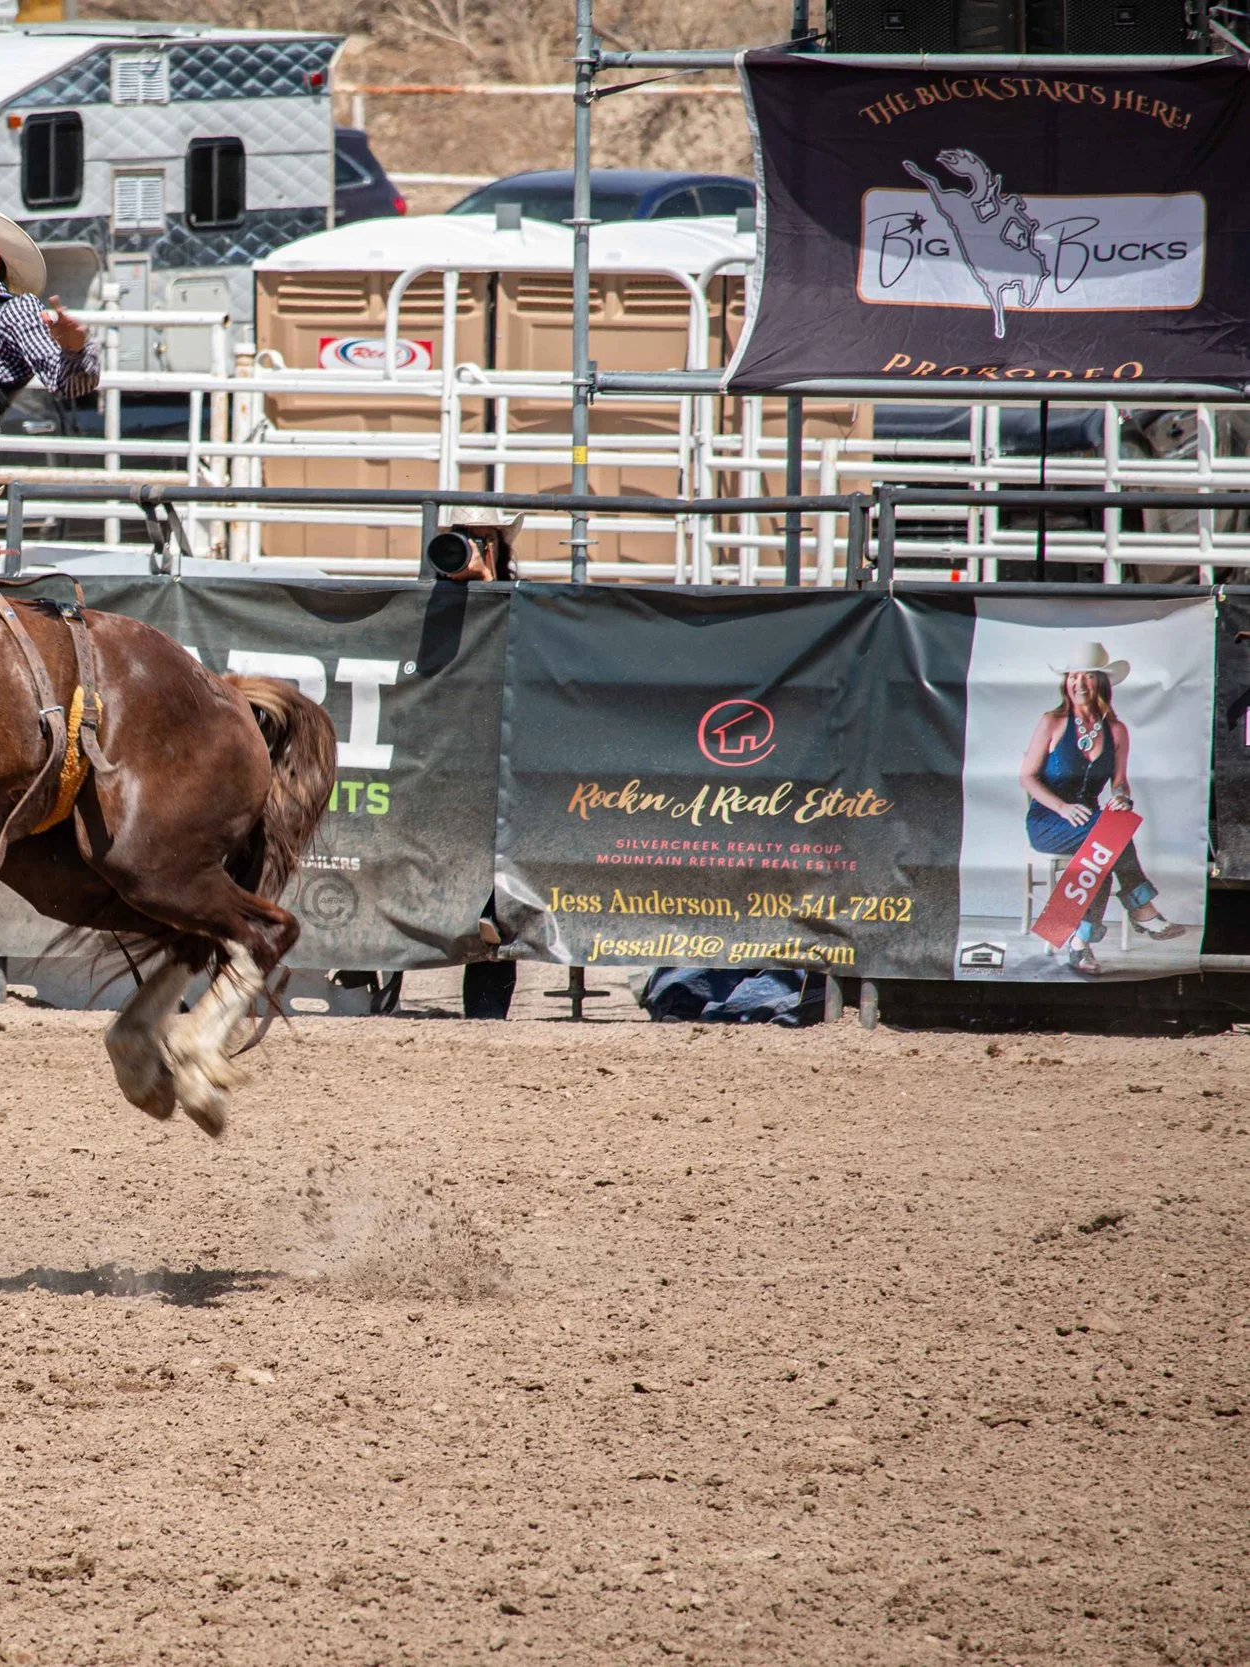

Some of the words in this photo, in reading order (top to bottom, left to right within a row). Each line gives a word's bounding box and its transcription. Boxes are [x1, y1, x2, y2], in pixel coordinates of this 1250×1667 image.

[858, 89, 917, 125] THE
[915, 77, 1003, 106] BUCK
[999, 77, 1106, 105] STARTS
[1111, 88, 1192, 131] HERE!
[867, 210, 950, 289] BIG
[1044, 216, 1188, 294] BUCKS
[567, 779, 674, 821] Rock'n
[671, 784, 710, 826] A
[709, 781, 793, 825] Real
[794, 787, 895, 824] Estate
[596, 854, 682, 867] MOUNTAIN
[689, 856, 755, 869] RETREAT
[761, 858, 799, 870] REAL
[806, 860, 858, 872] ESTATE
[616, 838, 720, 851] SILVERCREEK
[727, 841, 783, 853] REALTY
[790, 843, 842, 855] GROUP
[1064, 841, 1114, 906] Sold
[546, 887, 601, 913] Jess
[608, 888, 740, 922] Anderson,
[747, 892, 912, 922] 208-541-7262
